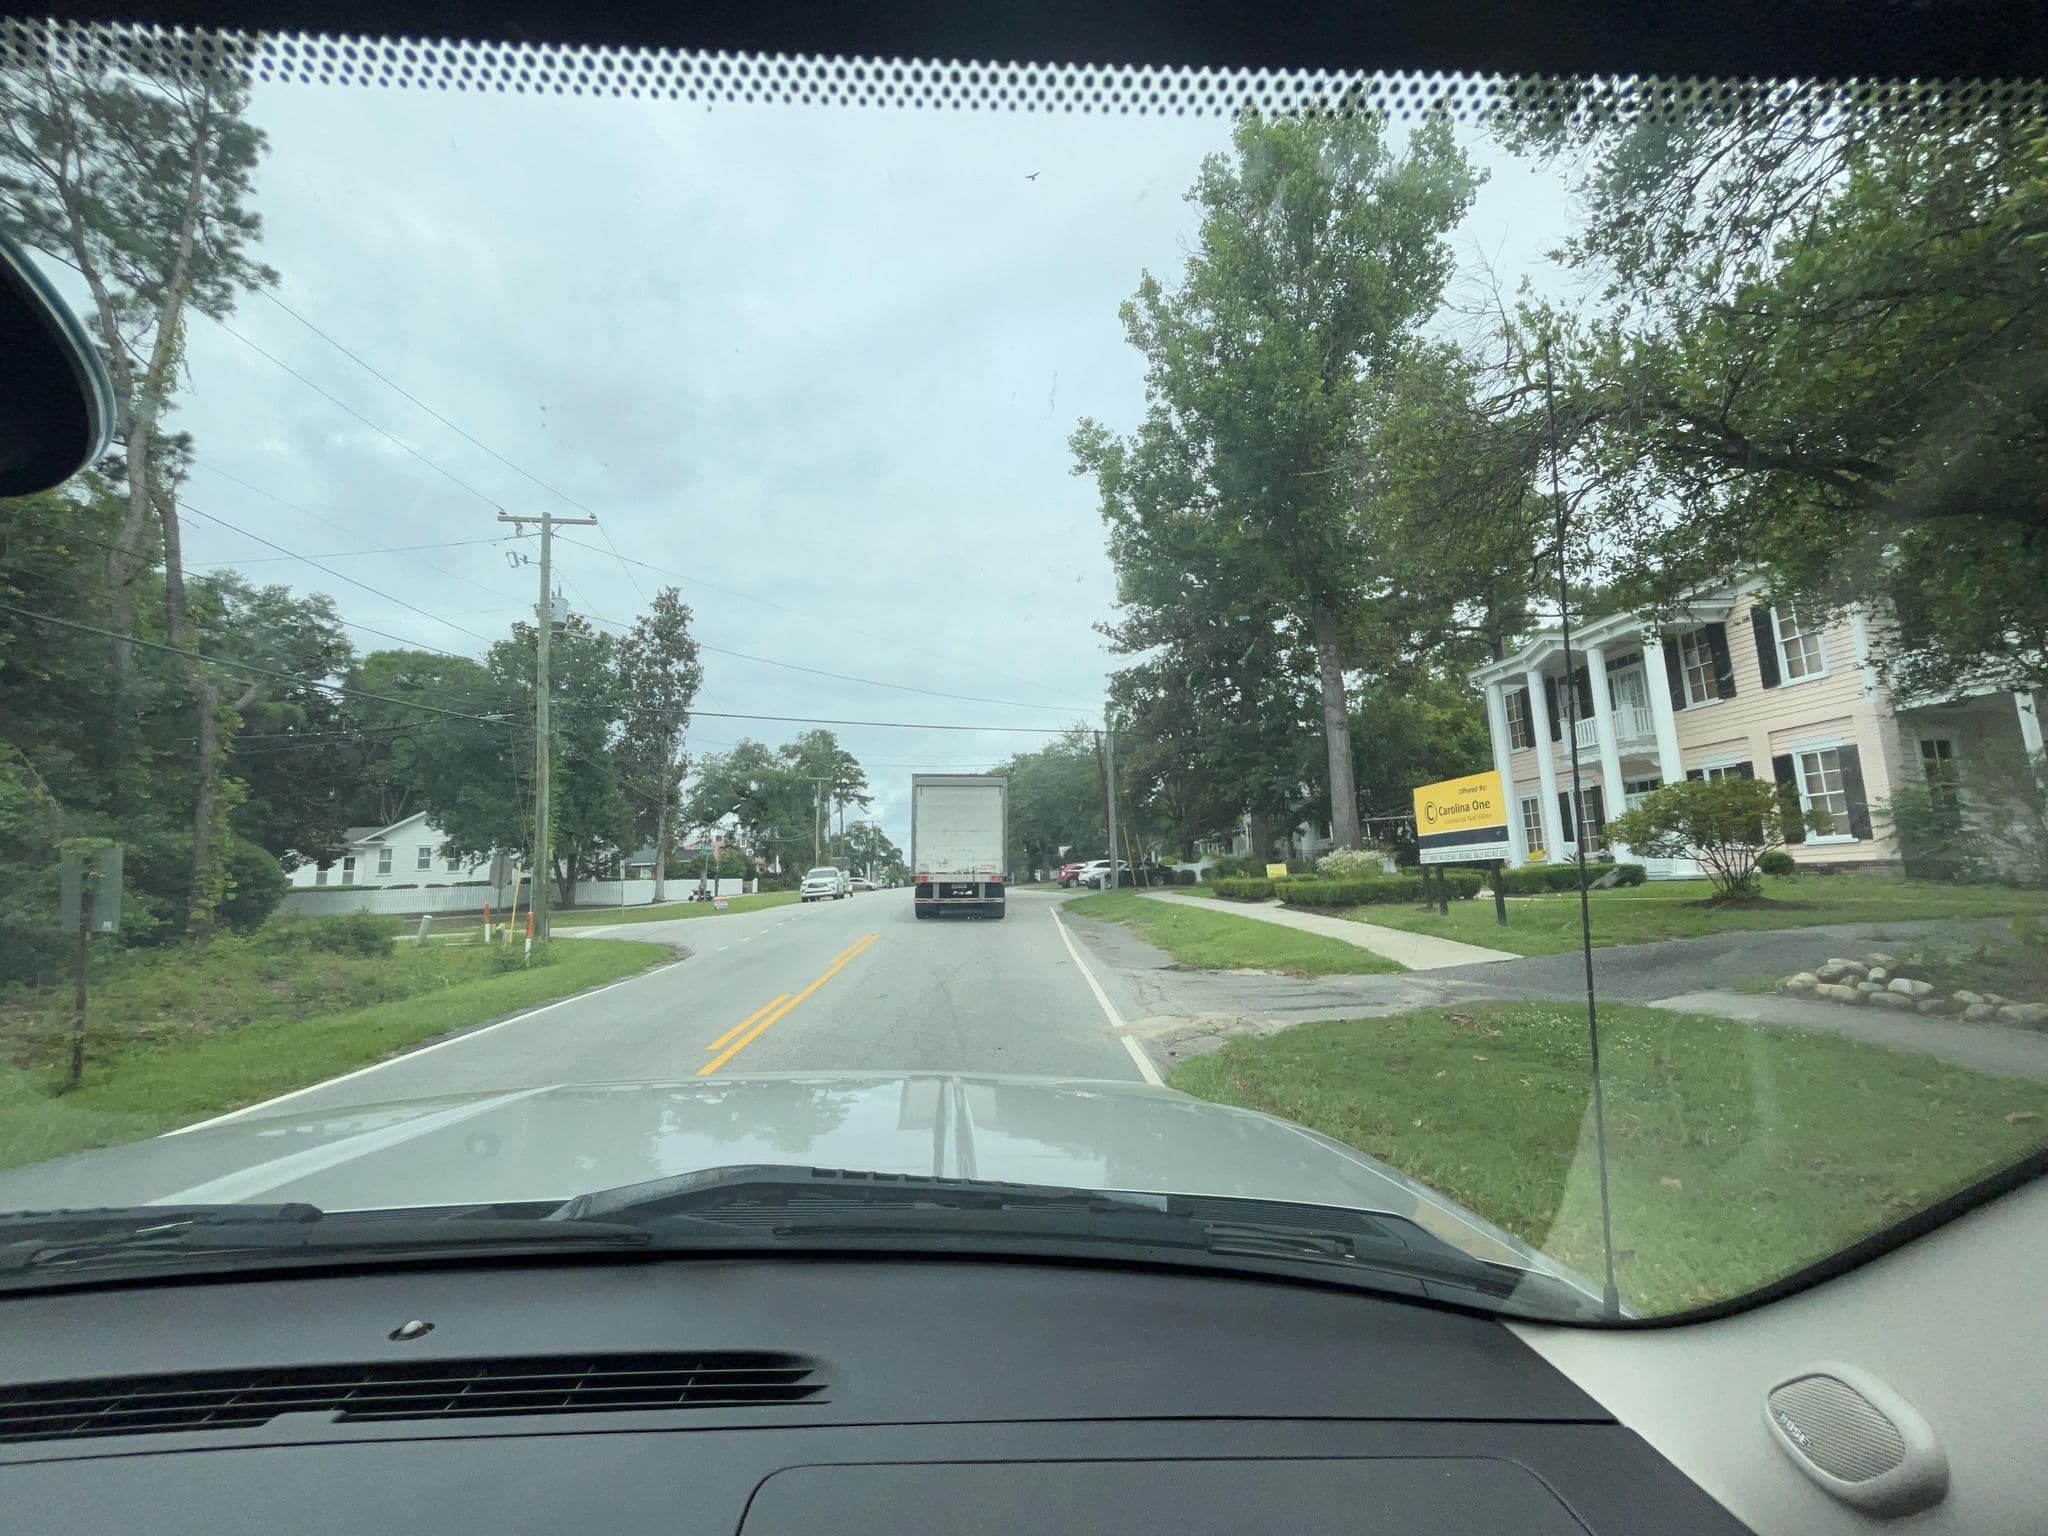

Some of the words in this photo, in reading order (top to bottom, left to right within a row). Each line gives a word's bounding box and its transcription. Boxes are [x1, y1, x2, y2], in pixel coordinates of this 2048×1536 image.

[1459, 785, 1478, 795] Offered
[1438, 803, 1470, 816] Carolina
[1472, 800, 1491, 810] One
